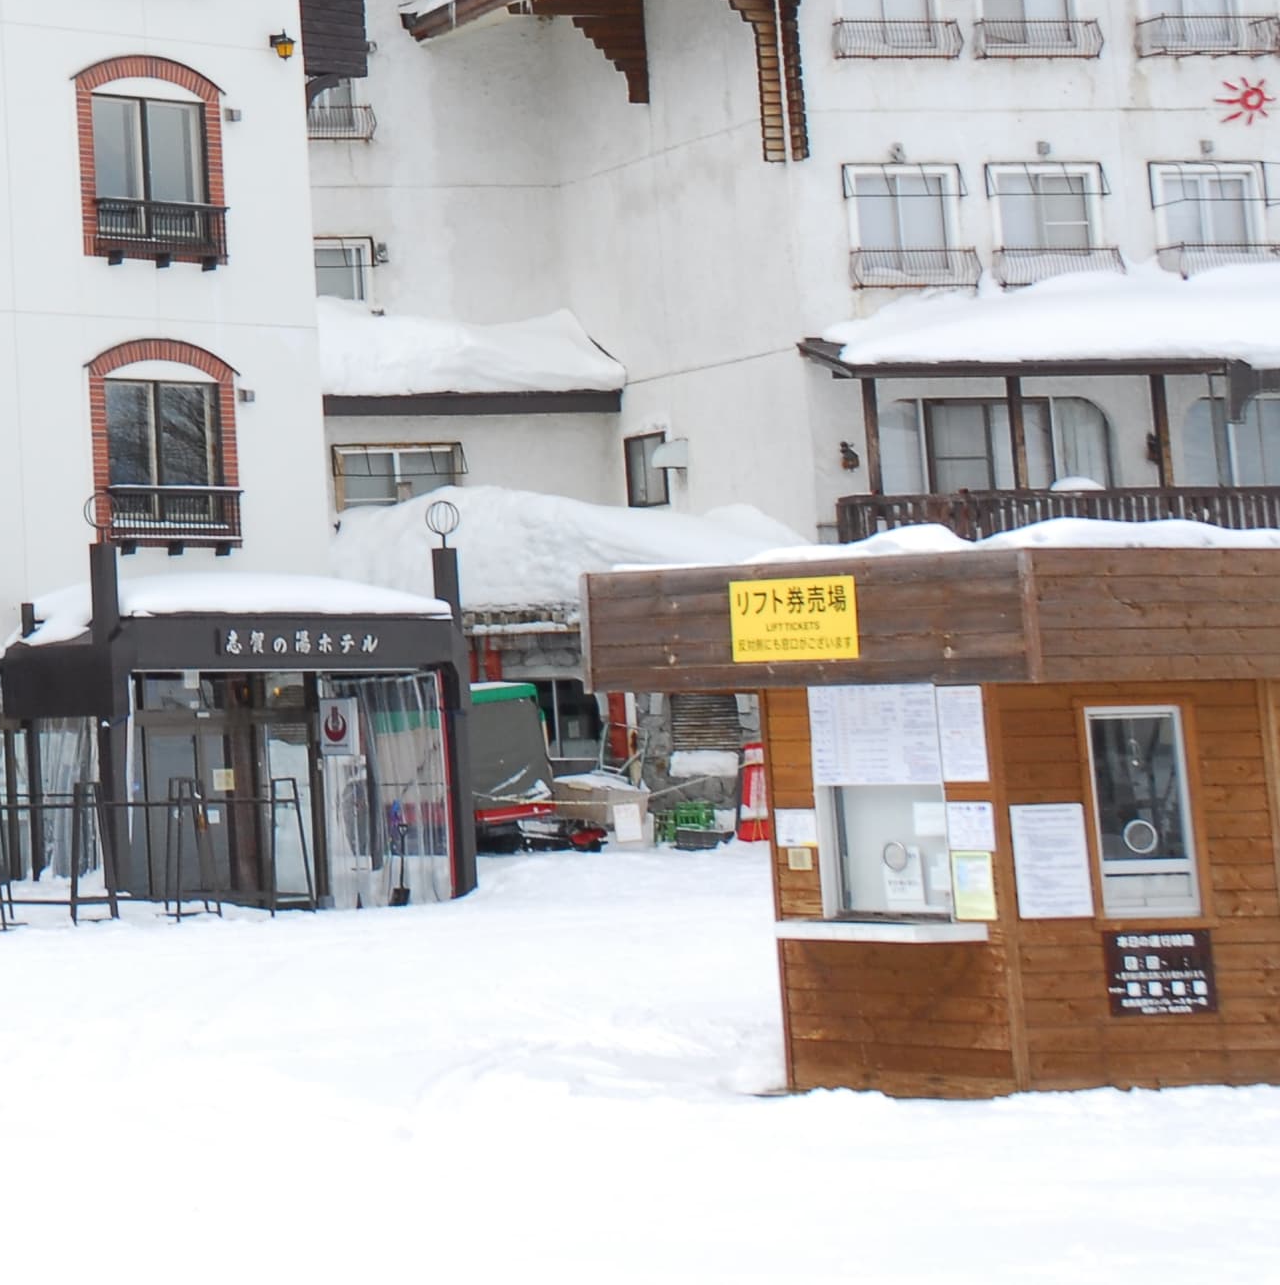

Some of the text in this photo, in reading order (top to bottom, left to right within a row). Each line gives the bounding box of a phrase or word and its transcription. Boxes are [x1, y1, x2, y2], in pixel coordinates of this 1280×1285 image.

[737, 585, 847, 616] リフト券売場
[226, 629, 378, 654] 志賀の湯ホテル
